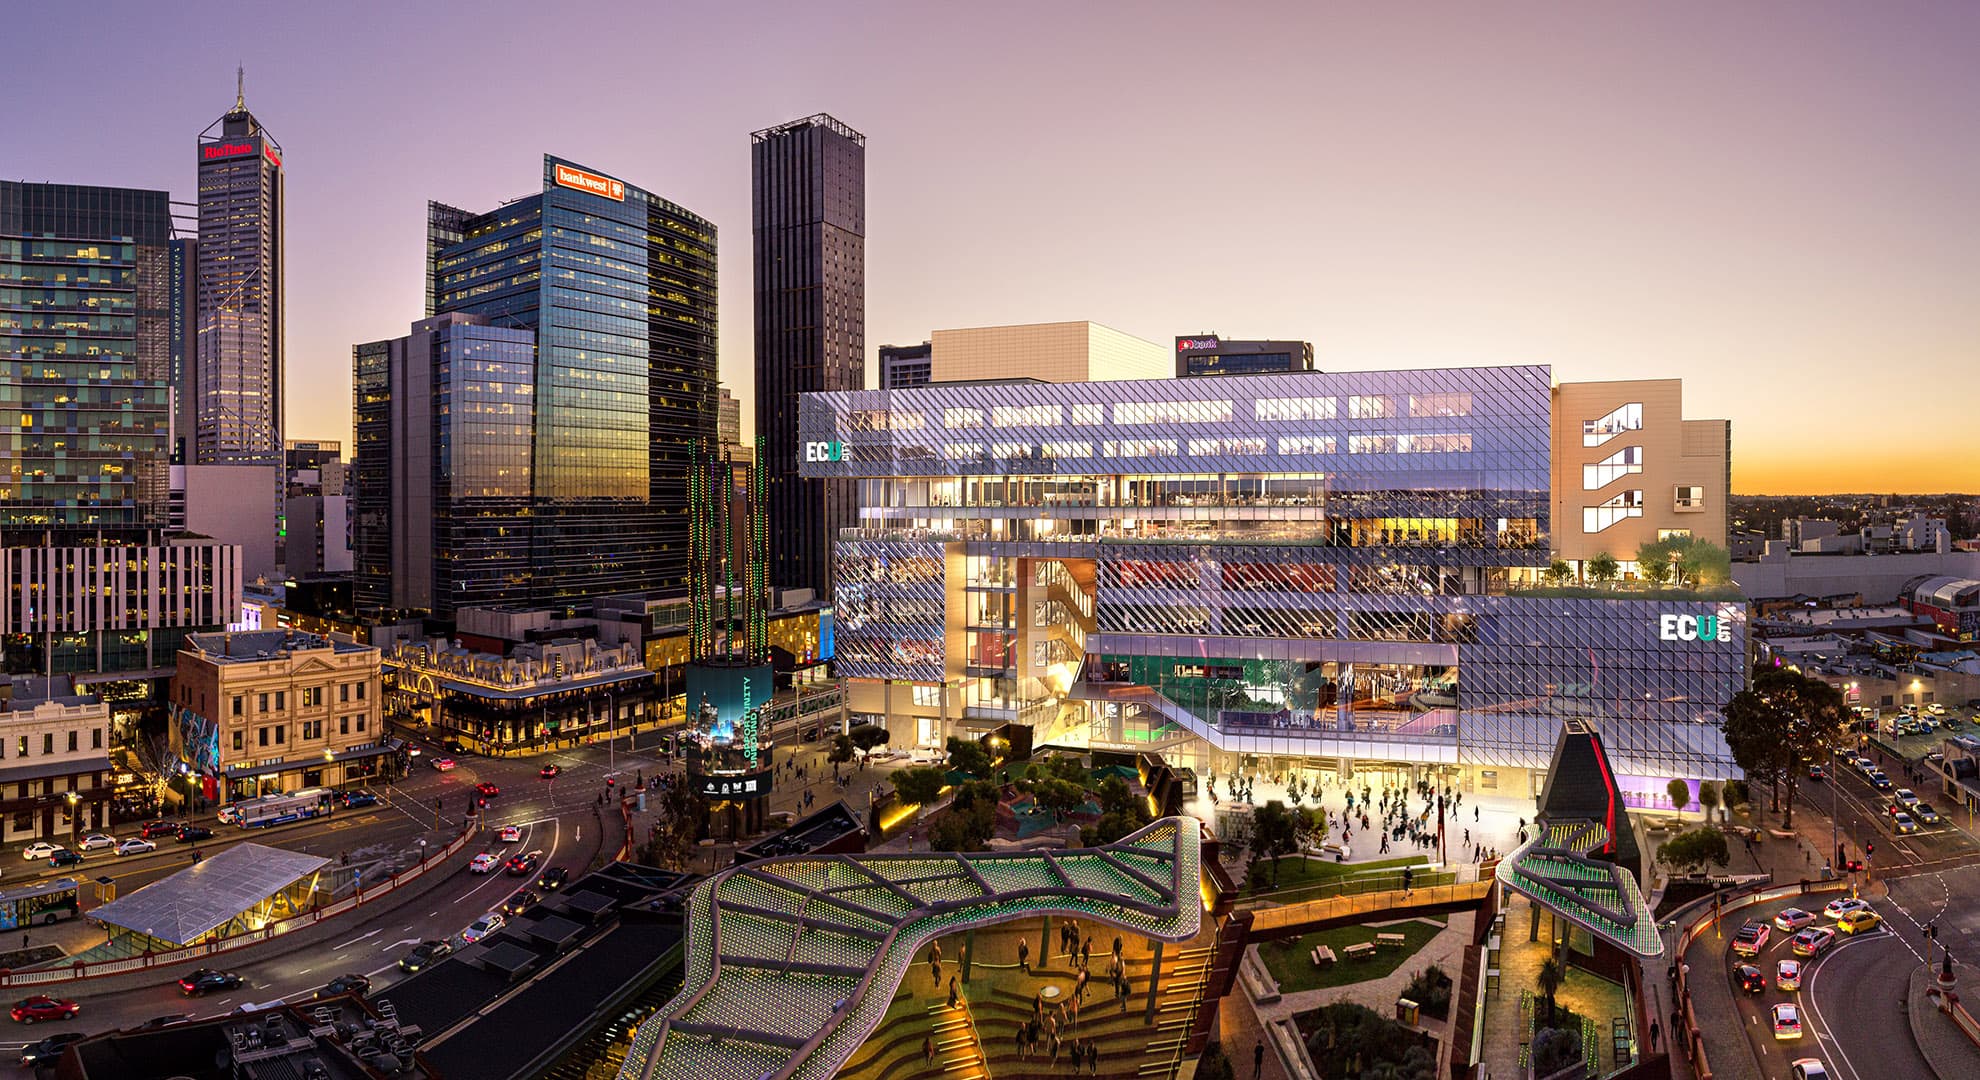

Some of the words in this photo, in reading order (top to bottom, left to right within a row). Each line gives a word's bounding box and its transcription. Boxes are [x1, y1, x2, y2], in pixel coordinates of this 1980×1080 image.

[560, 168, 607, 192] bankwest
[1193, 339, 1217, 350] bank
[806, 440, 842, 462] ECU
[841, 441, 850, 462] CITY
[1660, 614, 1717, 642] ECU
[743, 677, 751, 758] OPPORTUNITY
[750, 712, 758, 768] UNBOUND
